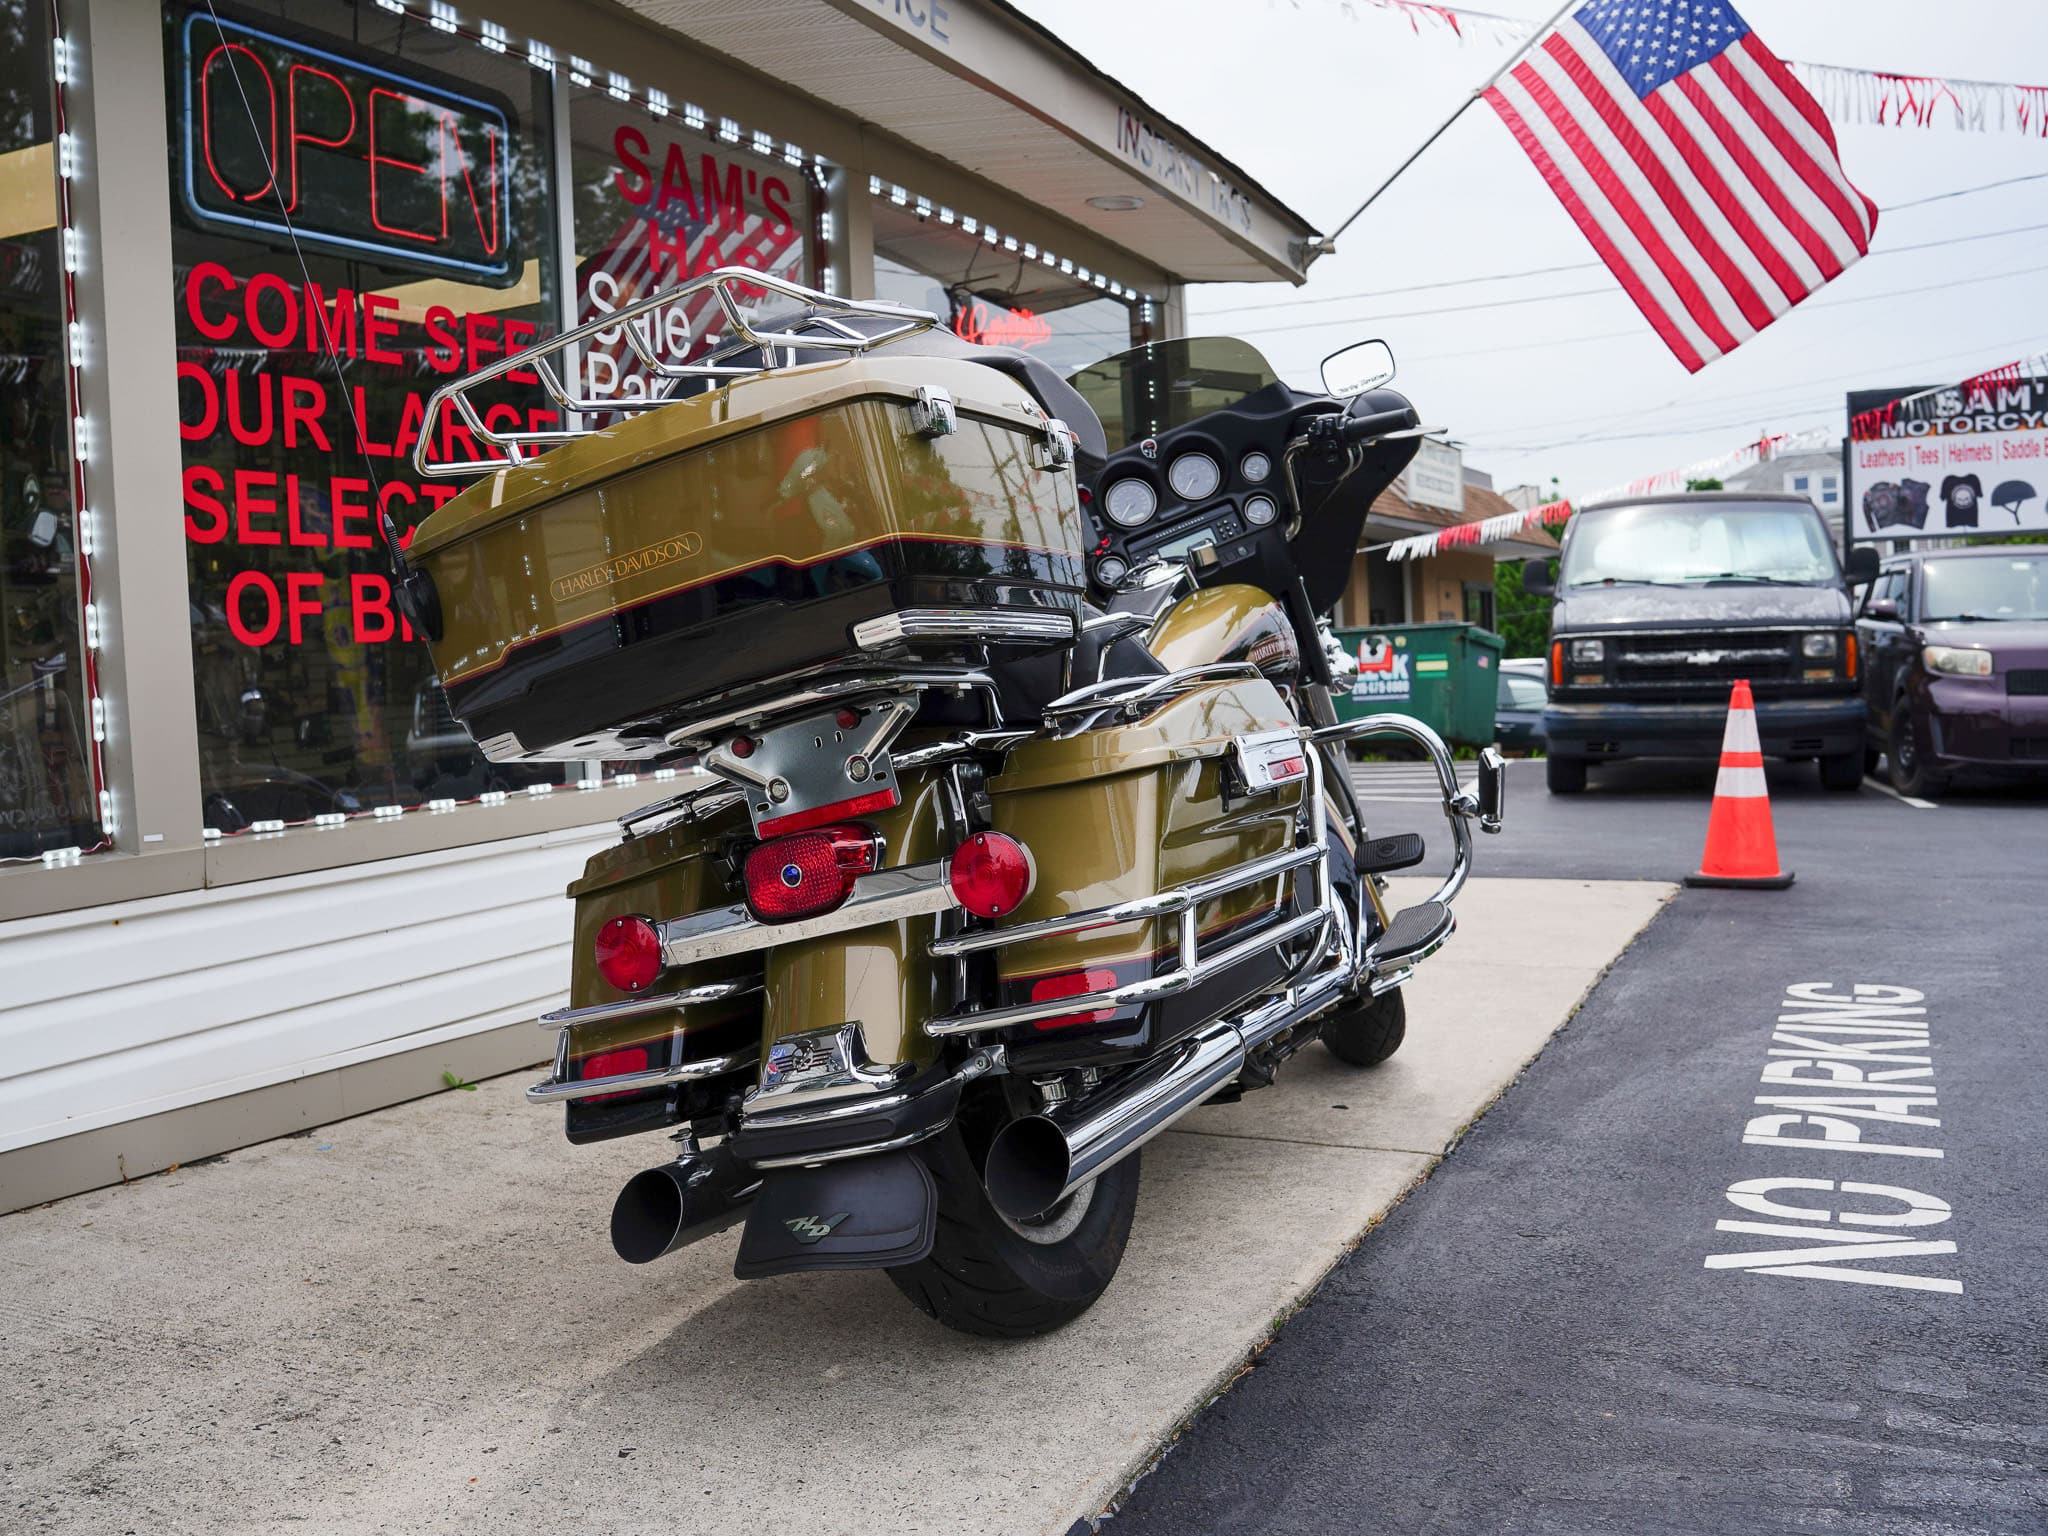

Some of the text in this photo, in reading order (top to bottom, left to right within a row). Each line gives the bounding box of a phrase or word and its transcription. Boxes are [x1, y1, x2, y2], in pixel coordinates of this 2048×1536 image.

[202, 43, 497, 255] OPEN
[613, 125, 794, 247] SAM'S
[186, 261, 539, 385] COME SEE
[177, 360, 333, 452] OUR
[1881, 410, 2048, 438] MOTORCY
[1860, 449, 1906, 469] Leathers
[1915, 445, 1939, 465] Tees
[1949, 442, 1993, 463] Helmets
[2002, 439, 2041, 460] Saddle
[182, 465, 467, 551] SELECT
[225, 569, 326, 647] OF
[559, 537, 692, 595] HARLEY-DAVIDSON
[1703, 981, 1964, 1295] NO PARKING
